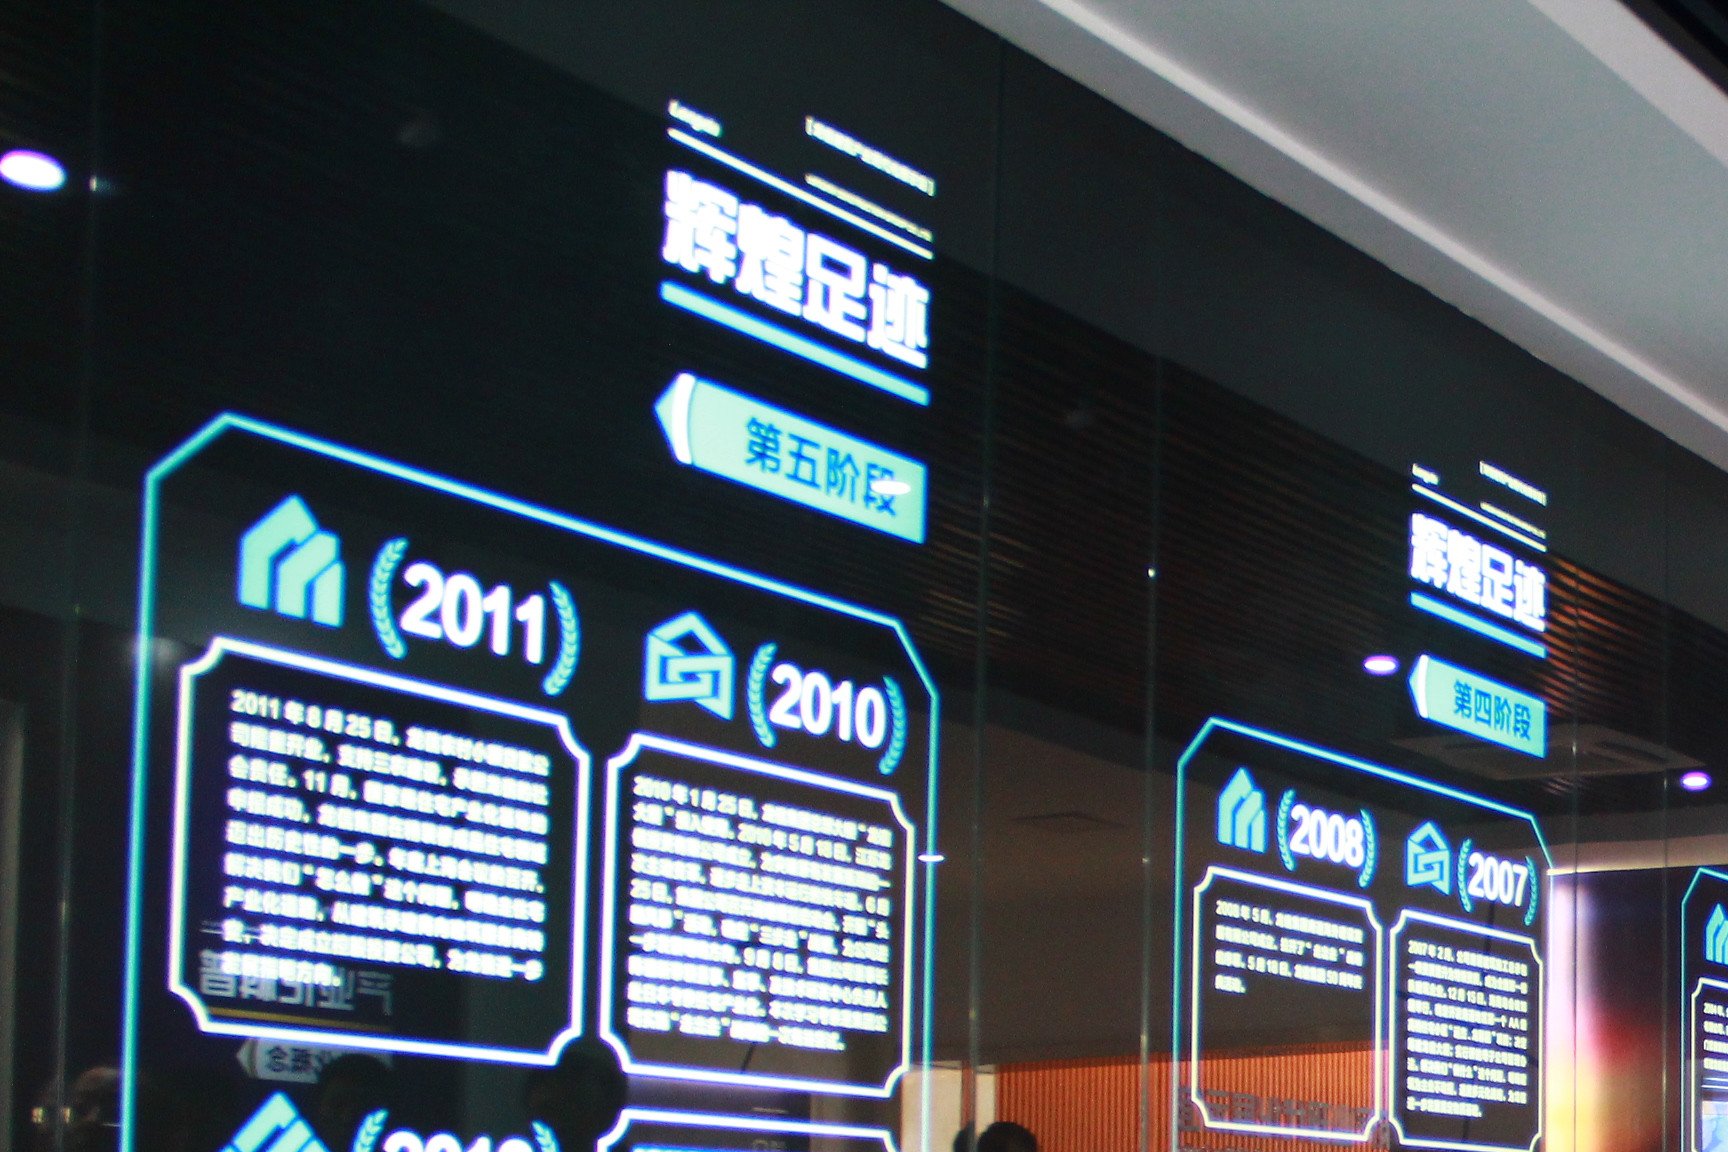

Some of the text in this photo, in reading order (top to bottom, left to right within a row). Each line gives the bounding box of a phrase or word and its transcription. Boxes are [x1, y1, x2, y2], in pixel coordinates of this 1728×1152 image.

[664, 169, 931, 370] 辉煌足迹
[744, 415, 899, 517] 第五阶段
[400, 559, 545, 665] 2011
[1410, 512, 1546, 633] 辉煌足迹
[767, 662, 888, 749] 2010
[1453, 679, 1532, 741] 第四阶段
[1290, 806, 1365, 869] 2008
[1468, 852, 1528, 908] 2007
